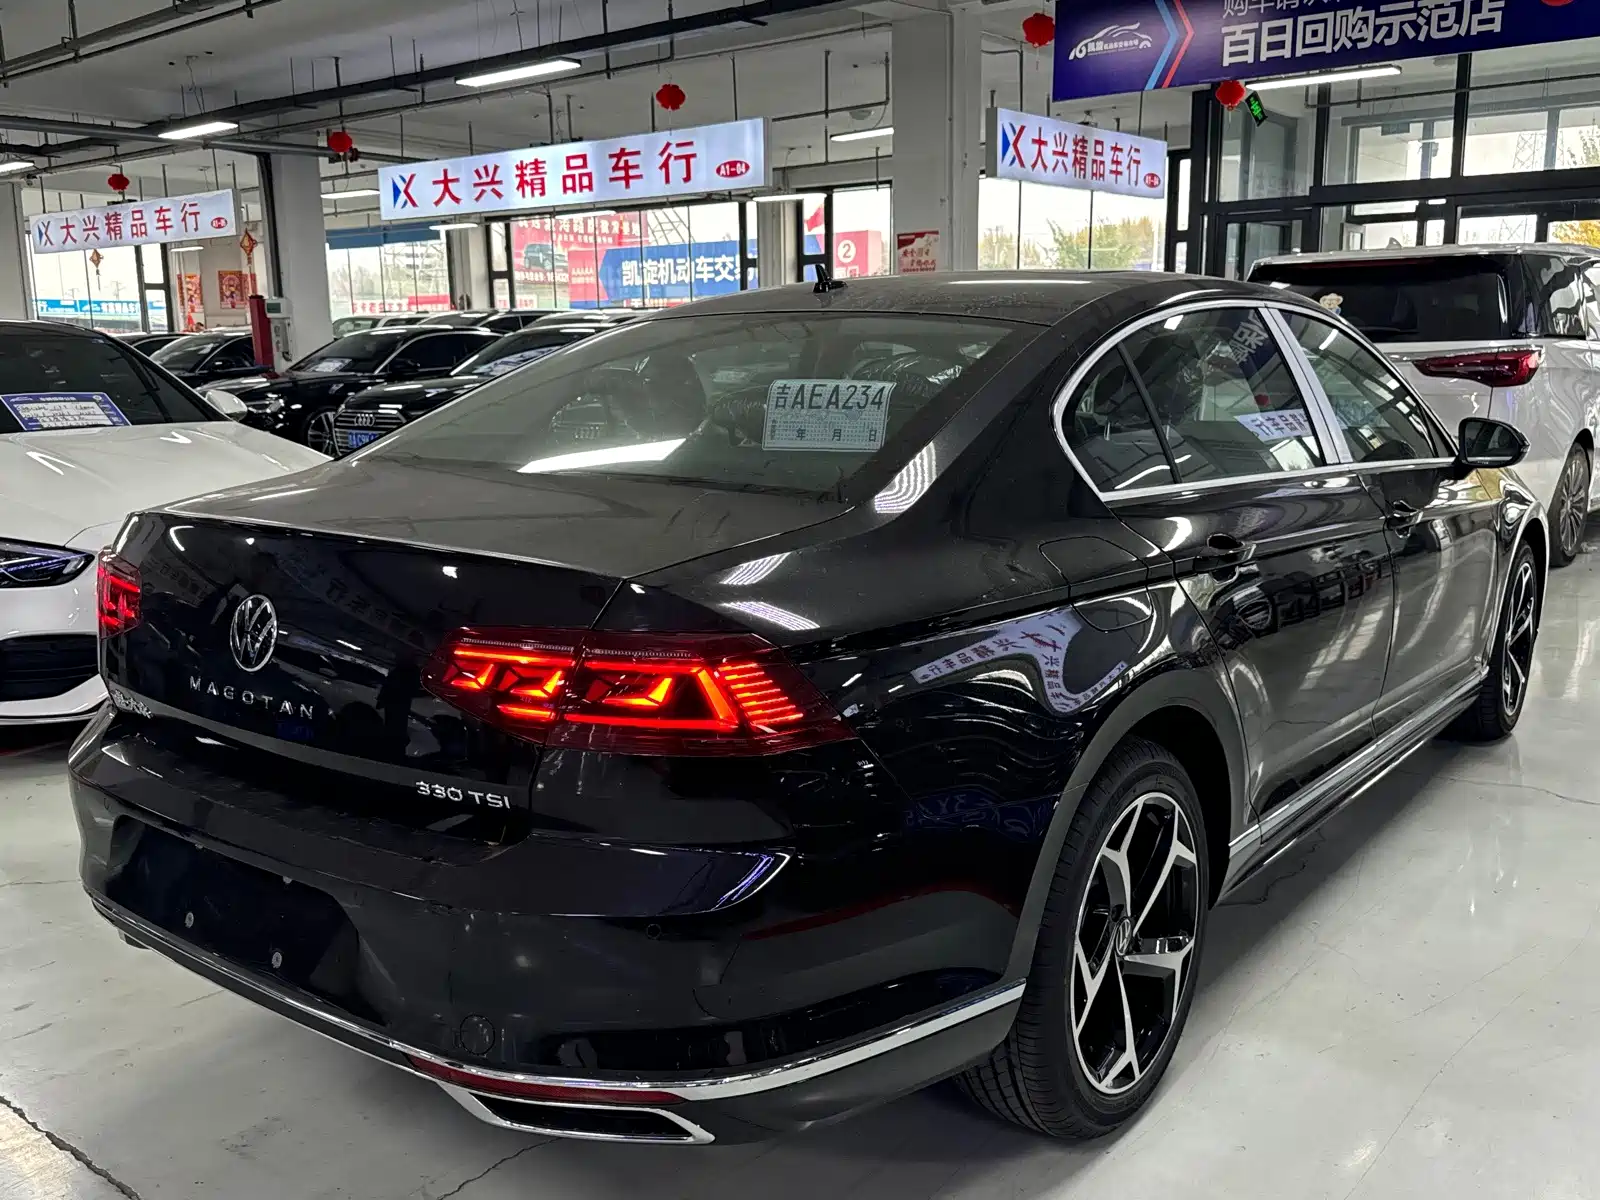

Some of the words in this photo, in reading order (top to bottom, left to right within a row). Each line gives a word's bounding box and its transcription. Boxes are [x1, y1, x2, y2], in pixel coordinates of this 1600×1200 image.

[1221, 0, 1505, 67] 百日回购示范店
[432, 140, 697, 207] 大兴精品车行
[1031, 126, 1141, 187] 大兴精品车行
[60, 202, 200, 244] 大兴精品车行
[842, 243, 852, 259] 2
[775, 383, 886, 410] 吉AEA234
[796, 428, 806, 440] 年
[832, 428, 842, 442] 月
[868, 429, 877, 443] 日
[189, 675, 314, 720] MAGOTAN
[415, 780, 463, 802] 330
[467, 790, 511, 809] TSI
